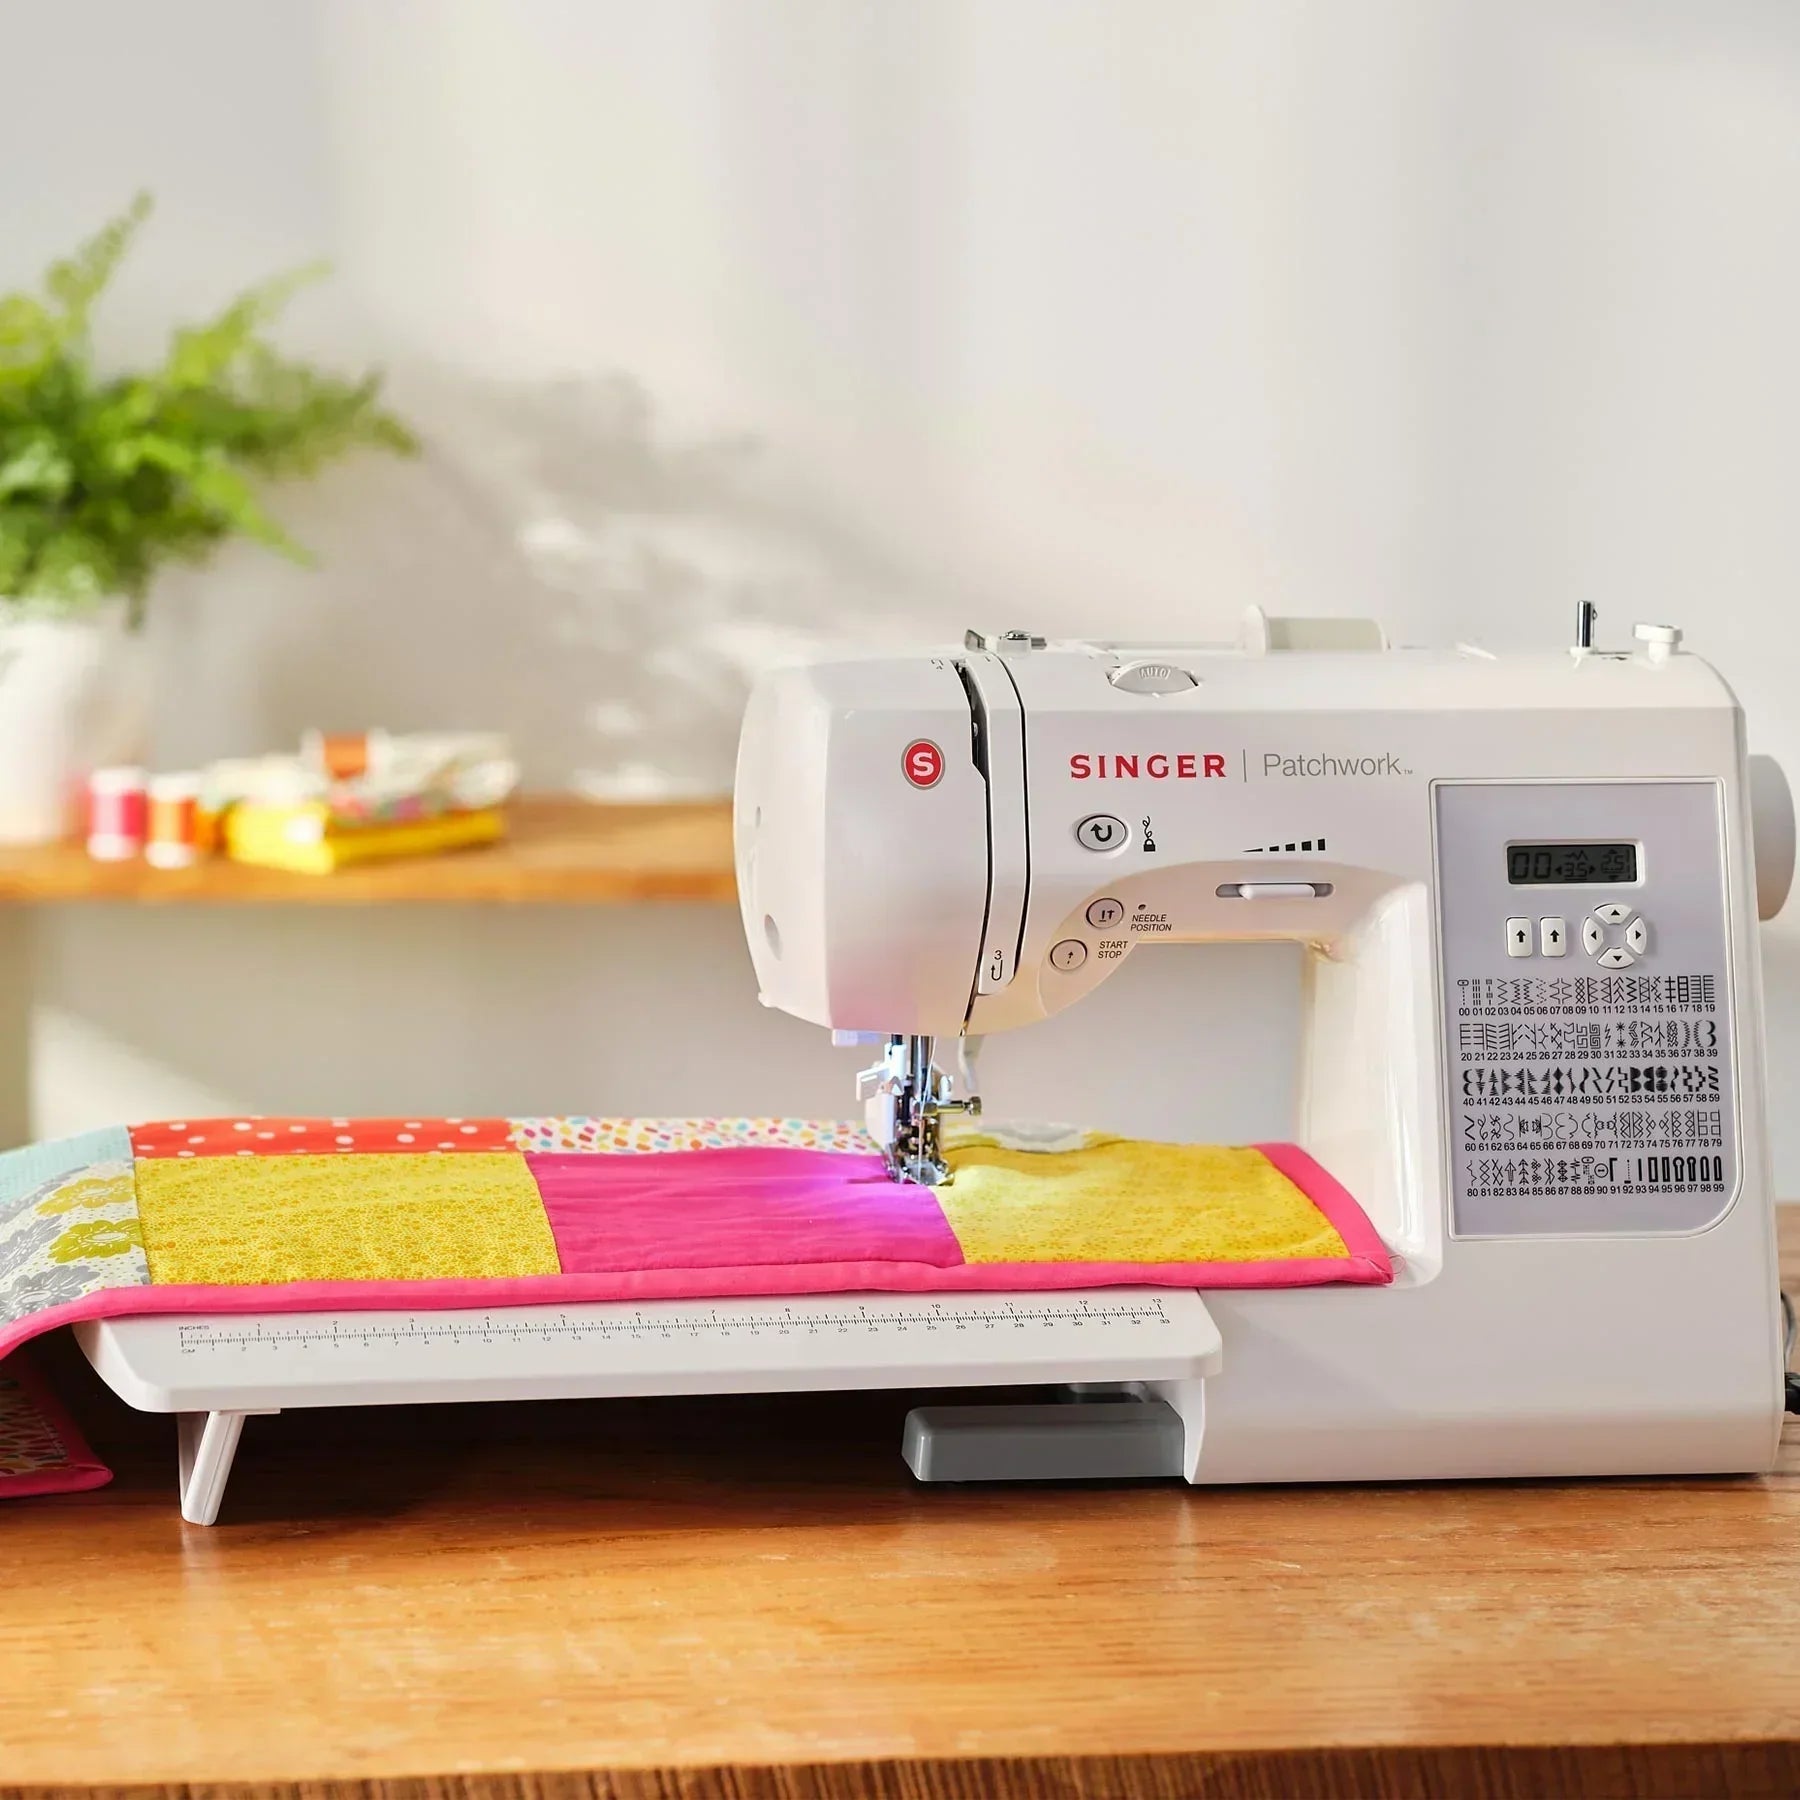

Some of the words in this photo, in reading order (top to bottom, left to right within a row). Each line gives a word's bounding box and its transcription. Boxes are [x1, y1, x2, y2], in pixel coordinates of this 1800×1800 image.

[912, 751, 934, 777] S
[1069, 754, 1227, 778] SINGER
[1264, 752, 1402, 777] Patchwork
[1132, 914, 1167, 922] NEEDLE
[1130, 923, 1172, 932] POSITION
[1099, 941, 1128, 949] START
[994, 950, 1002, 960] 3
[1097, 950, 1122, 959] STOP
[1459, 1008, 1470, 1016] 00
[1473, 1007, 1483, 1016] 01
[1485, 1007, 1496, 1016] 02
[1498, 1007, 1509, 1016] 03
[1511, 1007, 1522, 1016] 04
[1524, 1006, 1535, 1016] 05
[1537, 1006, 1548, 1015] 06
[1550, 1006, 1561, 1015] 07
[1562, 1006, 1574, 1015] 08
[1575, 1006, 1587, 1014] 09
[1589, 1005, 1600, 1015] 10
[1603, 1006, 1612, 1014] 11
[1614, 1005, 1625, 1014] 12
[1628, 1005, 1638, 1014] 13
[1640, 1005, 1650, 1013] 14
[1653, 1004, 1664, 1013] 15
[1666, 1004, 1677, 1013] 16
[1679, 1004, 1690, 1012] 17
[1692, 1004, 1702, 1013] 18
[1705, 1004, 1715, 1012] 19
[1461, 1053, 1472, 1062] 20
[1475, 1052, 1485, 1061] 21
[1487, 1052, 1498, 1061] 22
[1500, 1052, 1511, 1061] 23
[1513, 1052, 1524, 1060] 24
[1526, 1051, 1537, 1060] 25
[1539, 1051, 1550, 1060] 26
[1552, 1051, 1563, 1060] 27
[1565, 1051, 1576, 1060] 28
[1577, 1050, 1589, 1060] 29
[1590, 1050, 1602, 1059] 30
[1604, 1050, 1614, 1059] 31
[1616, 1050, 1628, 1059] 32
[1629, 1050, 1640, 1058] 33
[1642, 1050, 1653, 1059] 34
[1655, 1049, 1666, 1058] 35
[1668, 1049, 1679, 1058] 36
[1681, 1049, 1692, 1058] 37
[1694, 1049, 1705, 1057] 38
[1707, 1048, 1718, 1057] 39
[1463, 1098, 1475, 1107] 40
[1476, 1098, 1487, 1106] 41
[1489, 1097, 1501, 1106] 42
[1502, 1097, 1514, 1106] 43
[1515, 1097, 1526, 1105] 44
[1528, 1096, 1540, 1105] 45
[1541, 1096, 1552, 1105] 46
[1554, 1096, 1565, 1104] 47
[1567, 1096, 1578, 1104] 48
[1580, 1096, 1591, 1104] 49
[1593, 1095, 1604, 1104] 50
[1606, 1095, 1616, 1104] 51
[1619, 1095, 1630, 1104] 52
[1632, 1095, 1643, 1104] 53
[1644, 1095, 1655, 1104] 54
[1657, 1094, 1668, 1103] 55
[1670, 1094, 1682, 1103] 56
[1683, 1094, 1694, 1103] 57
[1696, 1094, 1707, 1102] 58
[1709, 1093, 1720, 1102] 59
[1465, 1143, 1476, 1152] 60
[1479, 1143, 1489, 1152] 61
[1491, 1142, 1503, 1151] 62
[1504, 1142, 1516, 1151] 63
[1517, 1142, 1528, 1151] 64
[1530, 1142, 1542, 1150] 65
[1543, 1142, 1554, 1150] 66
[1556, 1141, 1567, 1150] 67
[1569, 1141, 1580, 1150] 68
[1581, 1141, 1593, 1150] 69
[1595, 1141, 1606, 1149] 70
[1608, 1140, 1618, 1149] 71
[1620, 1140, 1632, 1149] 72
[1633, 1140, 1645, 1149] 73
[1646, 1140, 1657, 1148] 74
[1659, 1139, 1671, 1148] 75
[1672, 1139, 1684, 1148] 76
[1685, 1139, 1696, 1147] 77
[1698, 1138, 1710, 1148] 78
[1711, 1138, 1722, 1147] 79
[1467, 1188, 1478, 1197] 80
[1480, 1188, 1491, 1197] 81
[1493, 1188, 1505, 1197] 82
[1506, 1187, 1517, 1196] 83
[1519, 1187, 1530, 1196] 84
[1532, 1187, 1544, 1196] 85
[1545, 1186, 1557, 1196] 86
[1558, 1186, 1569, 1196] 87
[1571, 1186, 1582, 1195] 88
[1584, 1186, 1595, 1195] 89
[1597, 1186, 1608, 1195] 90
[1610, 1185, 1621, 1194] 91
[1622, 1185, 1634, 1194] 92
[1635, 1185, 1647, 1194] 93
[1648, 1185, 1660, 1194] 94
[1661, 1184, 1673, 1193] 95
[1674, 1184, 1686, 1193] 96
[1687, 1184, 1698, 1193] 97
[1700, 1184, 1712, 1193] 98
[1713, 1184, 1725, 1192] 99
